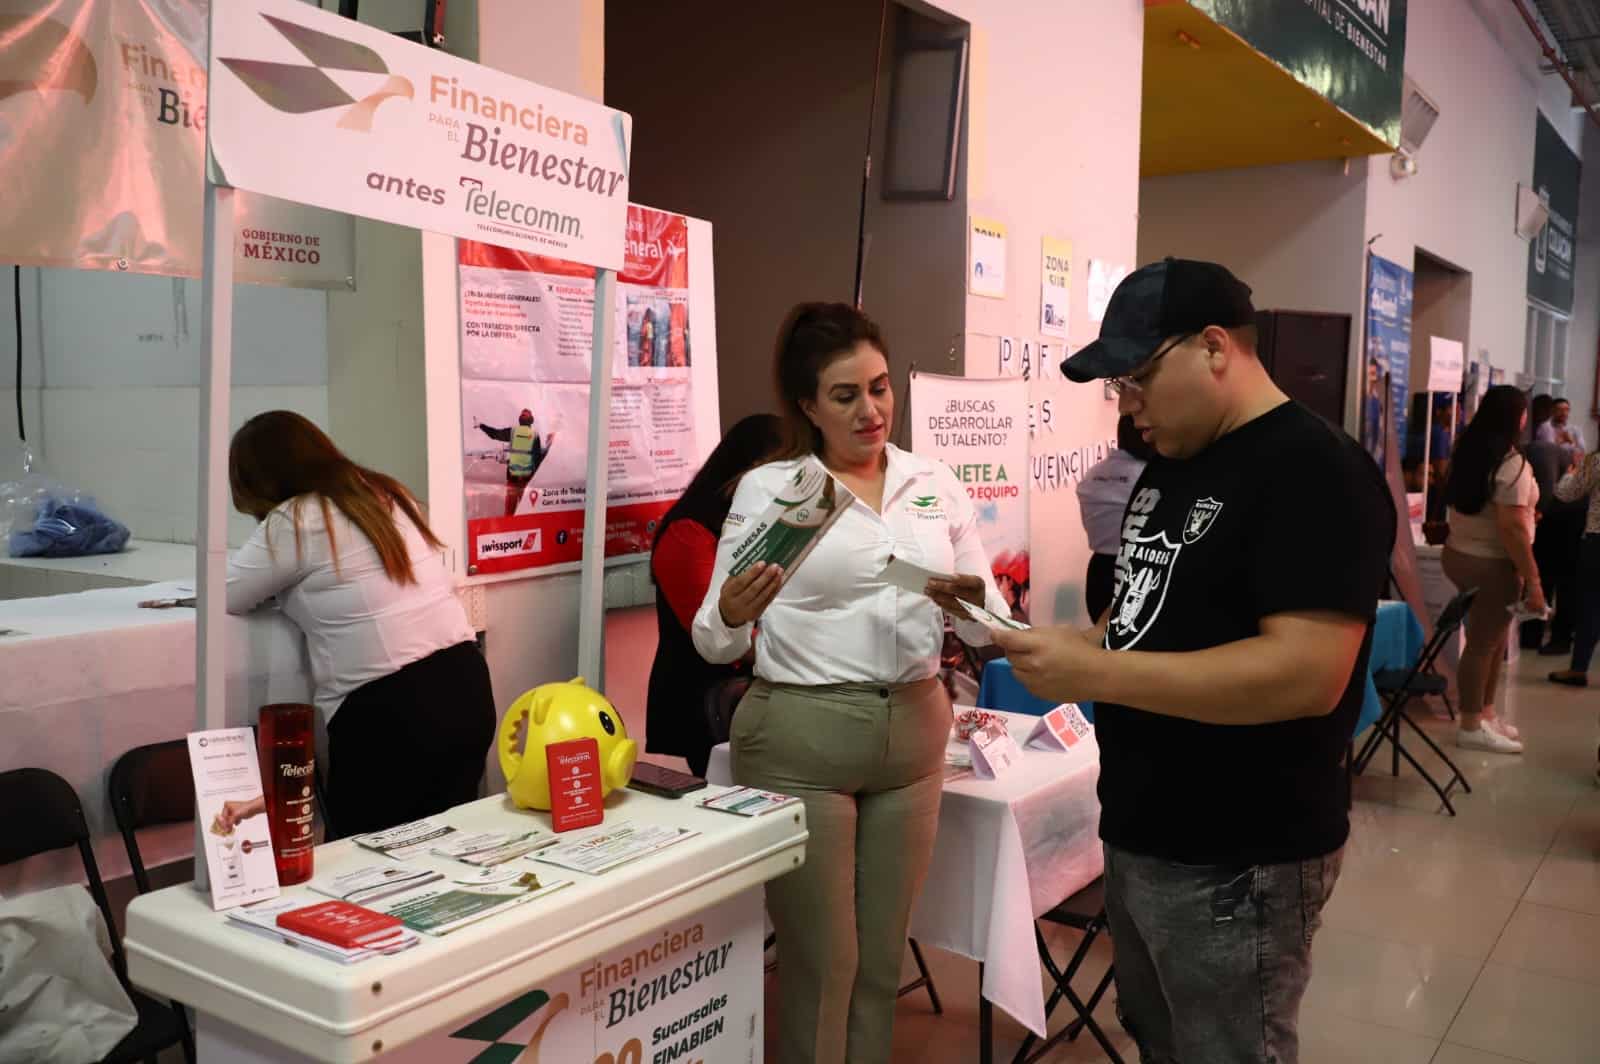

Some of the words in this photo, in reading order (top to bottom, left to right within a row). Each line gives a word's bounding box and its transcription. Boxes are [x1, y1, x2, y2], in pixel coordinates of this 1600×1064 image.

[1347, 22, 1387, 71] BIENESTAR
[428, 112, 460, 129] PARA
[430, 74, 589, 146] Financiera
[447, 130, 460, 143] EL
[460, 122, 625, 198] Bienestar
[366, 171, 446, 206] antes
[242, 228, 302, 245] GOBIERNO
[305, 235, 320, 247] DE
[244, 242, 320, 265] MÉXICO
[1046, 255, 1069, 272] ZONA
[945, 399, 995, 413] ¿BUSCAS
[928, 416, 1012, 430] DESARROLLAR
[934, 433, 948, 446] TU
[952, 434, 1007, 447] TALENTO?
[950, 463, 992, 482] NETE
[994, 464, 1008, 481] A
[542, 488, 559, 497] Zona
[977, 486, 1019, 499] EQUIPO
[731, 521, 767, 560] REMESAS
[1129, 543, 1170, 566] RAIDERS
[579, 923, 705, 998] Financiera
[606, 941, 733, 1029] Bienestar
[651, 993, 728, 1046] Sucursales
[652, 1016, 724, 1064] FINABIEN
